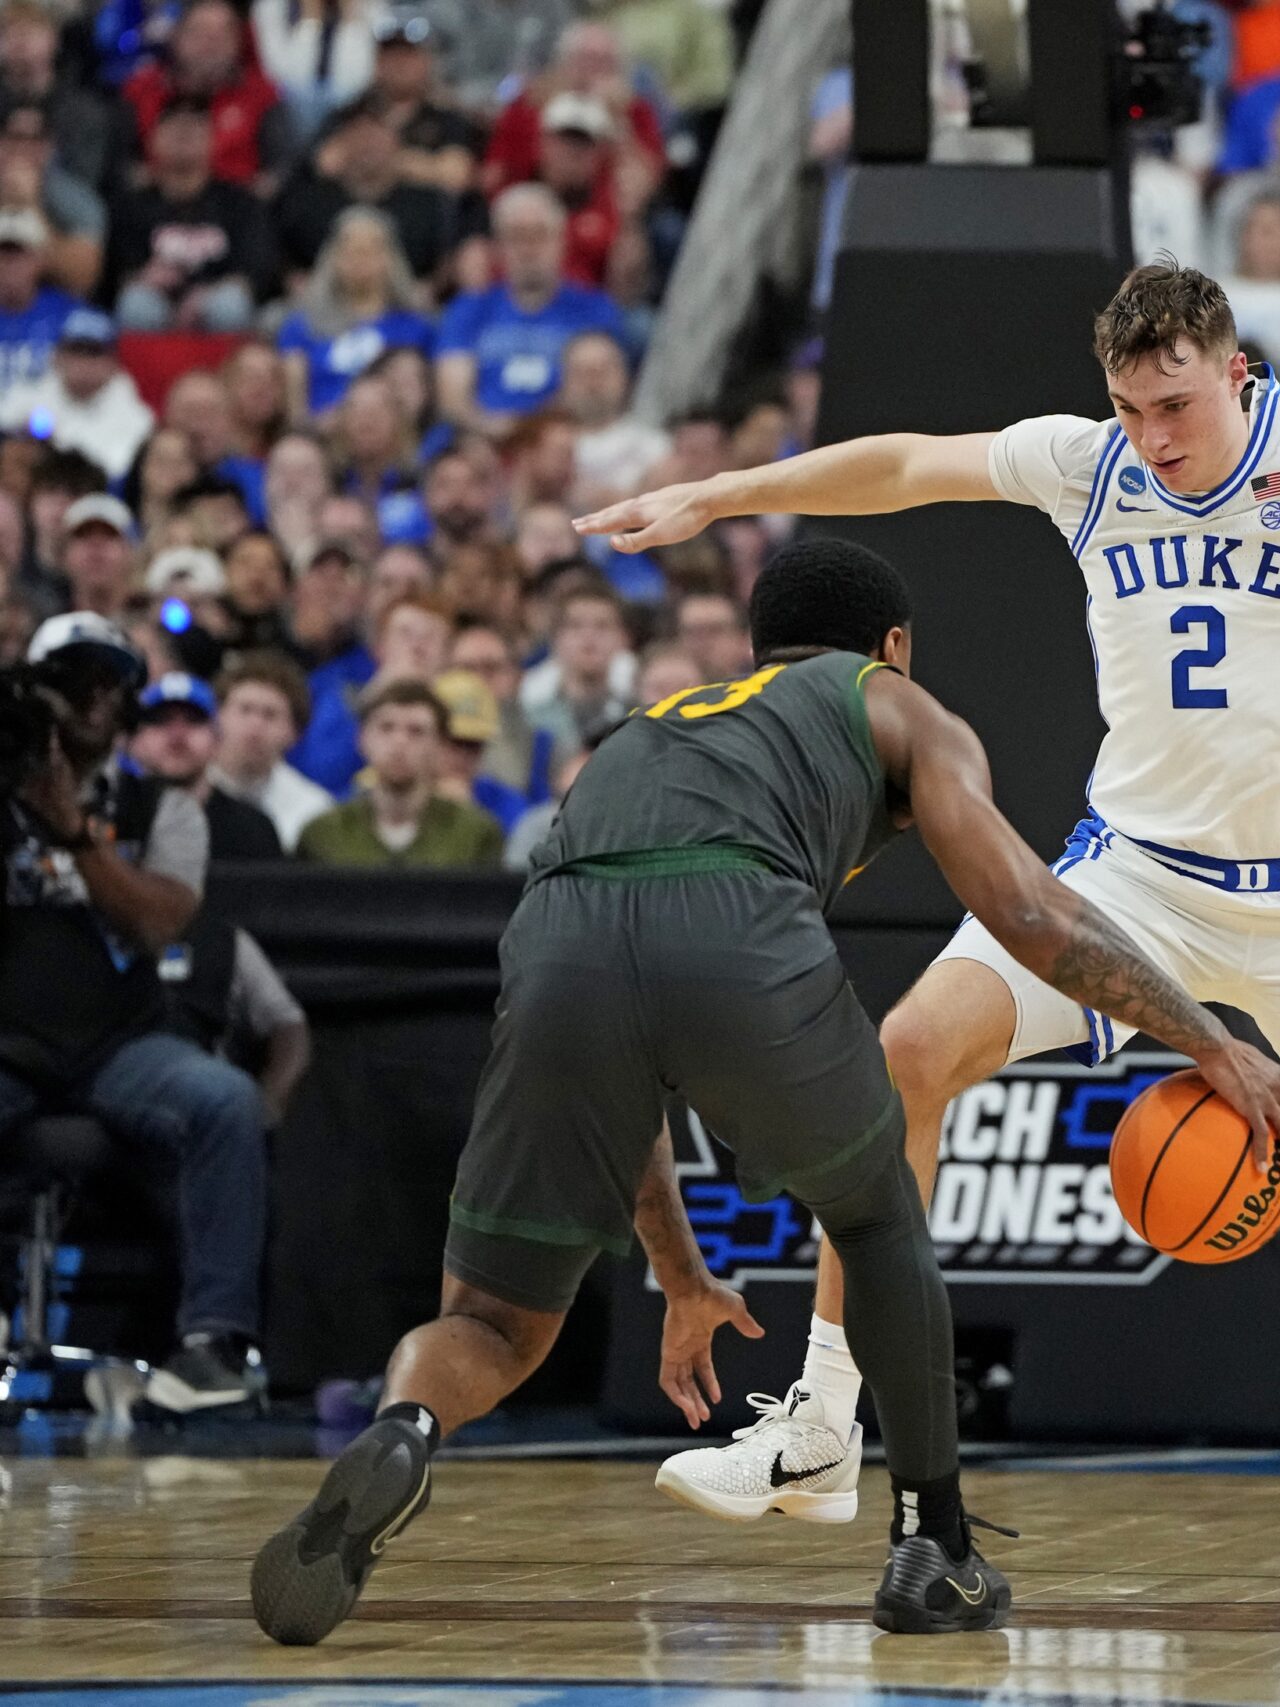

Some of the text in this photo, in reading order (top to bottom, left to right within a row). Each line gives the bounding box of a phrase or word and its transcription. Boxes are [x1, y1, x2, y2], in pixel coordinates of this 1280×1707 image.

[1120, 473, 1144, 492] NCAA
[1170, 605, 1229, 709] 2
[1235, 863, 1269, 890] D
[928, 1163, 1153, 1247] DNES
